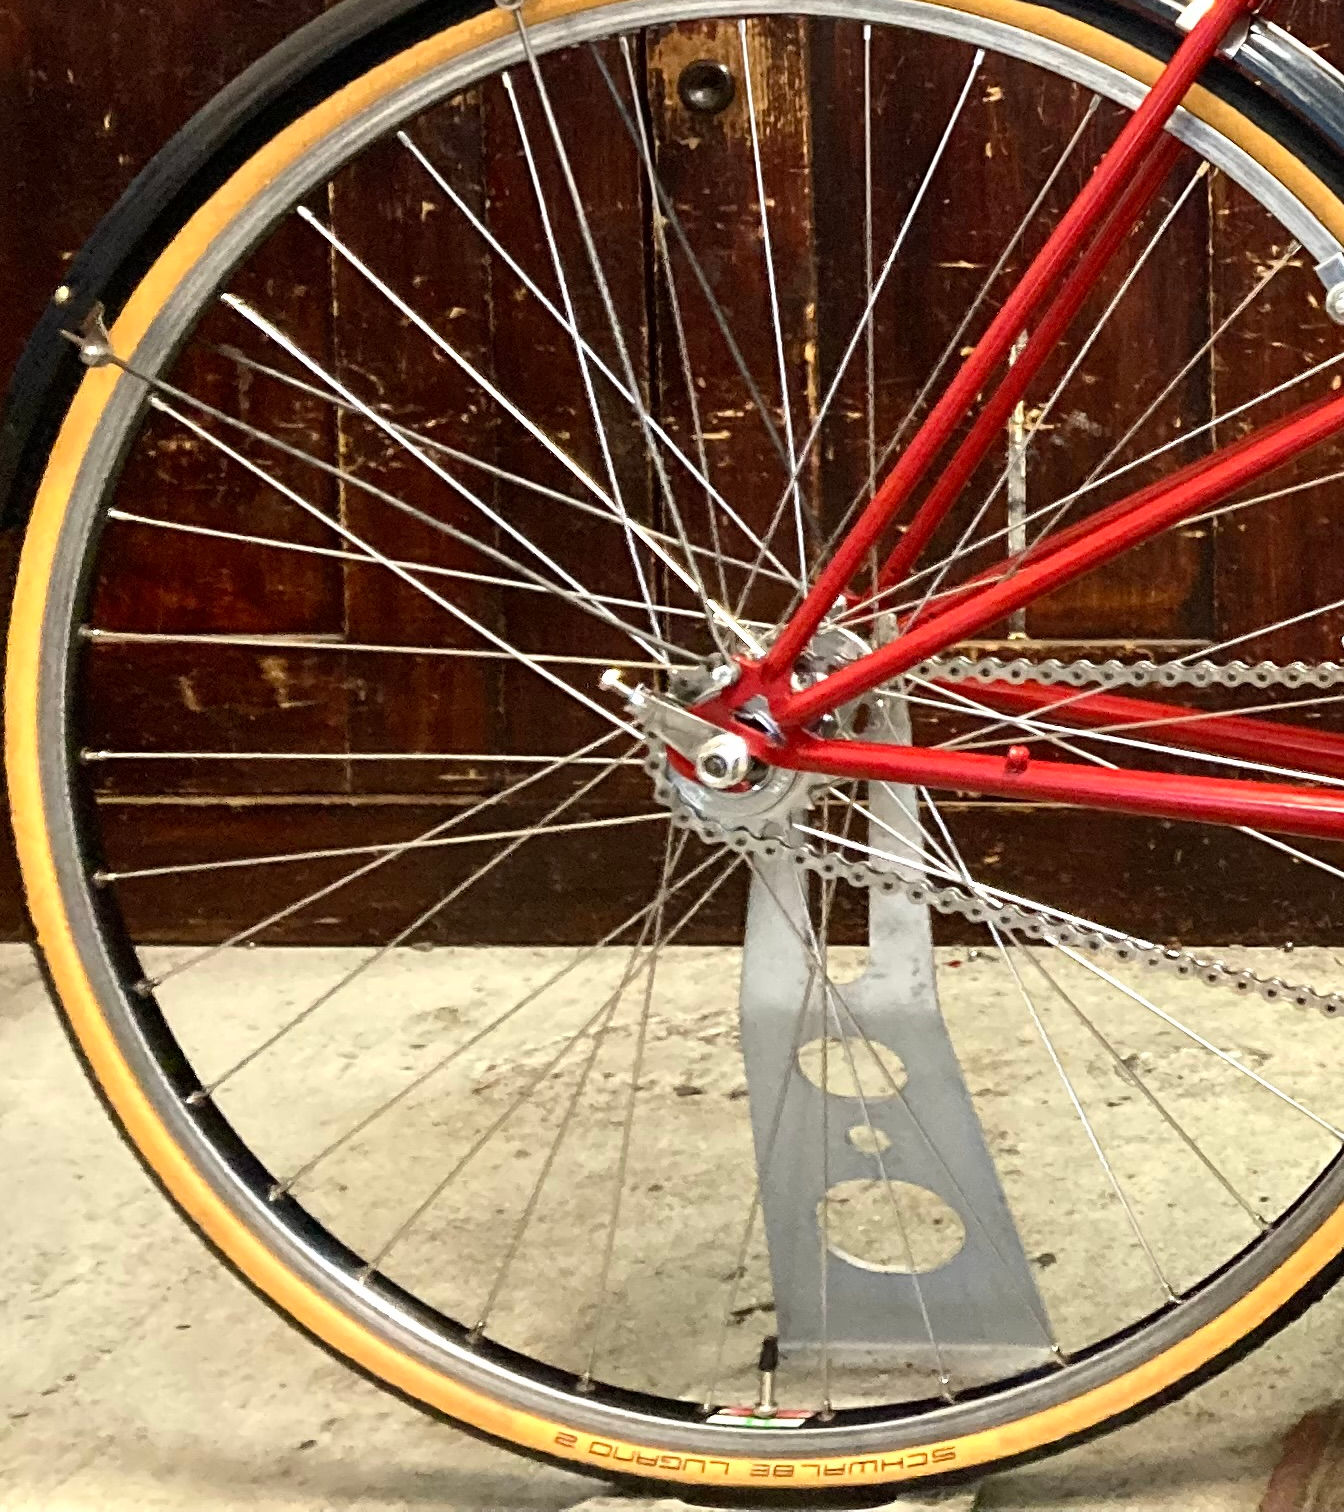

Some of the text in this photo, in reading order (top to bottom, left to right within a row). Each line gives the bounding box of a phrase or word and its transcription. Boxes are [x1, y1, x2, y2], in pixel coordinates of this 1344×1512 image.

[554, 1431, 957, 1478] SCHWALBE LUGANO 2
